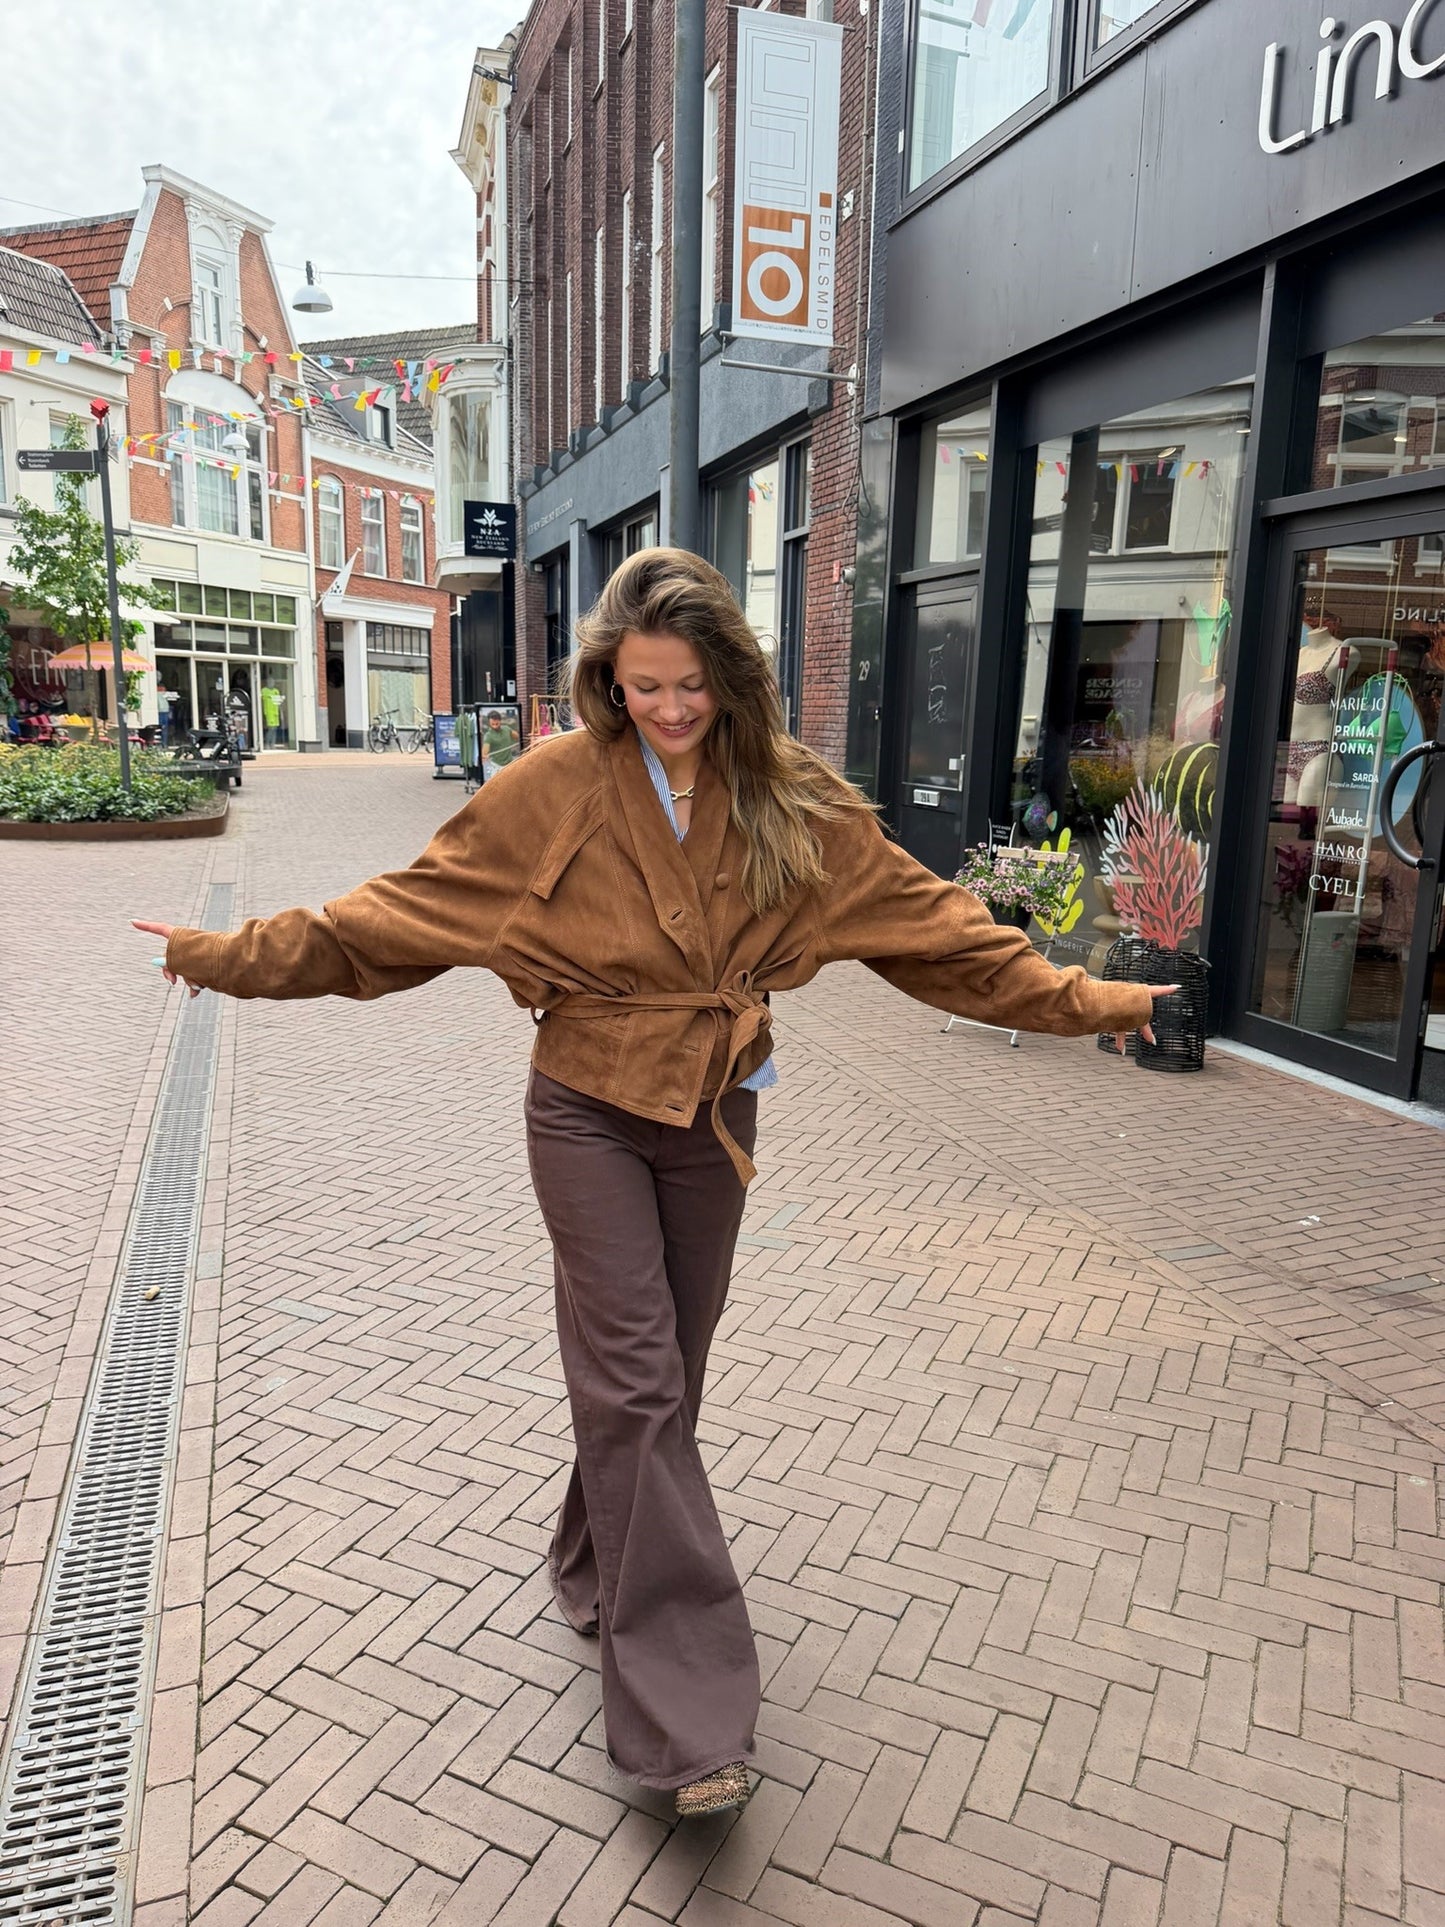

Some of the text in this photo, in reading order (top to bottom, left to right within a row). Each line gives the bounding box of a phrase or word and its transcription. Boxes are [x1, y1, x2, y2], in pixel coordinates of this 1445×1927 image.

[747, 217, 806, 317] 10
[816, 214, 832, 331] EDELSMID
[858, 660, 871, 681] 29
[1329, 697, 1387, 712] MARIE JO
[1334, 725, 1375, 738] PRIMA
[1331, 742, 1374, 756] DONNA
[1352, 772, 1379, 784] SARDA
[1325, 807, 1363, 827] Aubade
[1316, 841, 1368, 861] HANRO
[1309, 874, 1366, 900] CYELL
